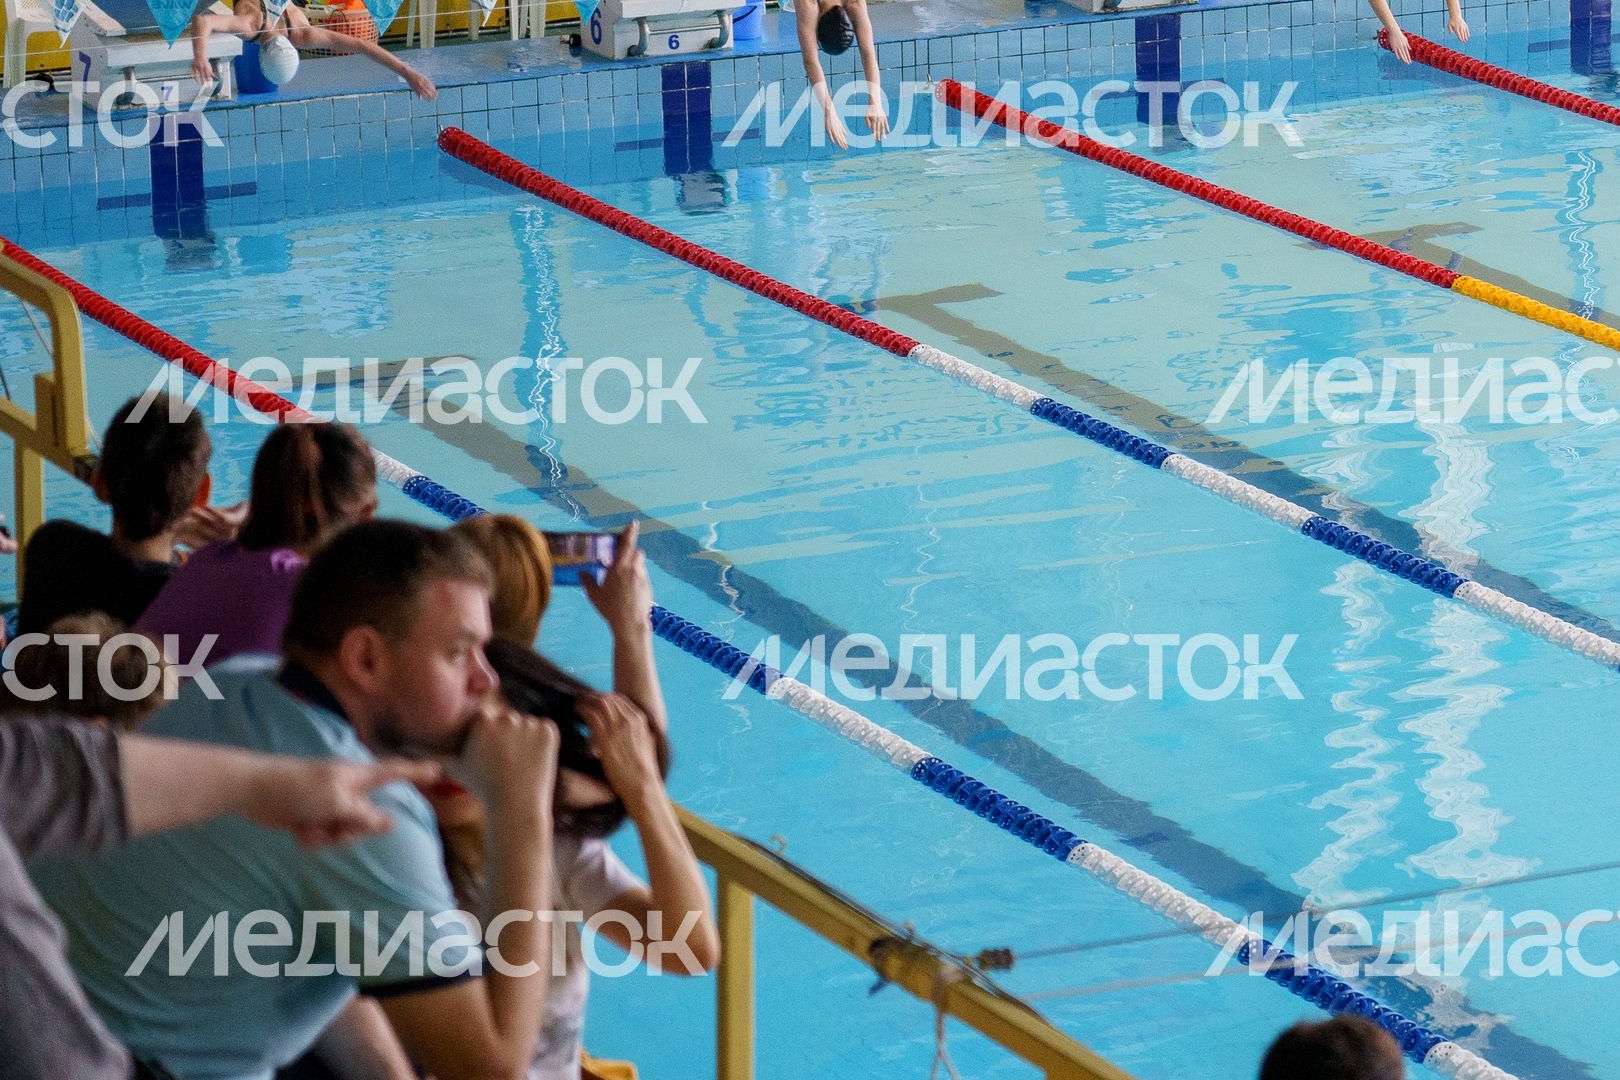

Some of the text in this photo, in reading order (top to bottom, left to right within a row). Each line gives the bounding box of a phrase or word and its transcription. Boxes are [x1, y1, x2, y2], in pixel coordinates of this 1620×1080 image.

[591, 7, 602, 45] 6
[668, 34, 680, 50] 6
[79, 50, 91, 94] 7
[161, 86, 173, 100] 7
